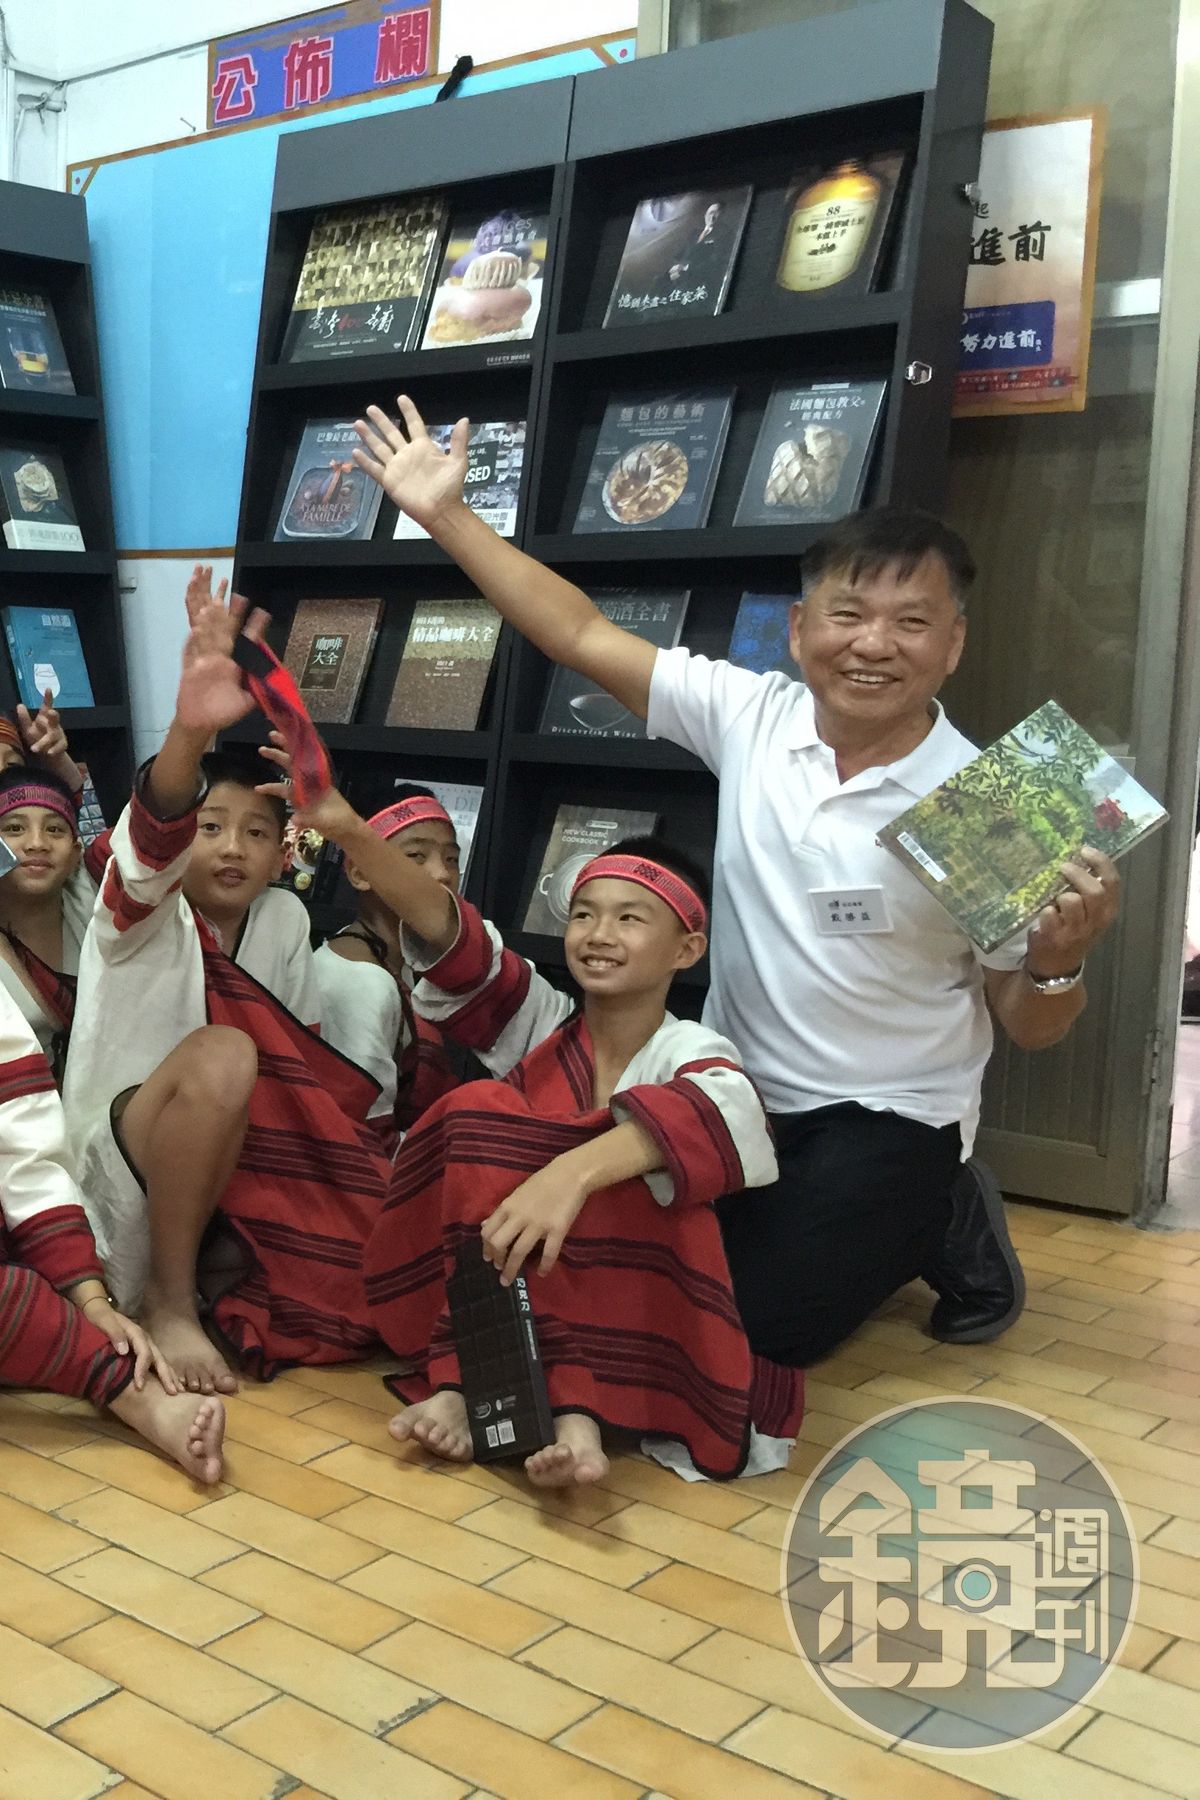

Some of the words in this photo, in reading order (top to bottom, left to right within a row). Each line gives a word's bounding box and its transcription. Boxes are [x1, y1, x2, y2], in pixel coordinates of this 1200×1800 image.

[212, 8, 431, 123] 公佈欄
[463, 465, 491, 484] SED
[595, 601, 672, 622] 萄酒全書
[315, 637, 343, 650] 咖啡
[412, 626, 494, 643] 精品咖啡大全
[311, 651, 339, 665] 大全
[516, 1277, 531, 1312] 巧克力
